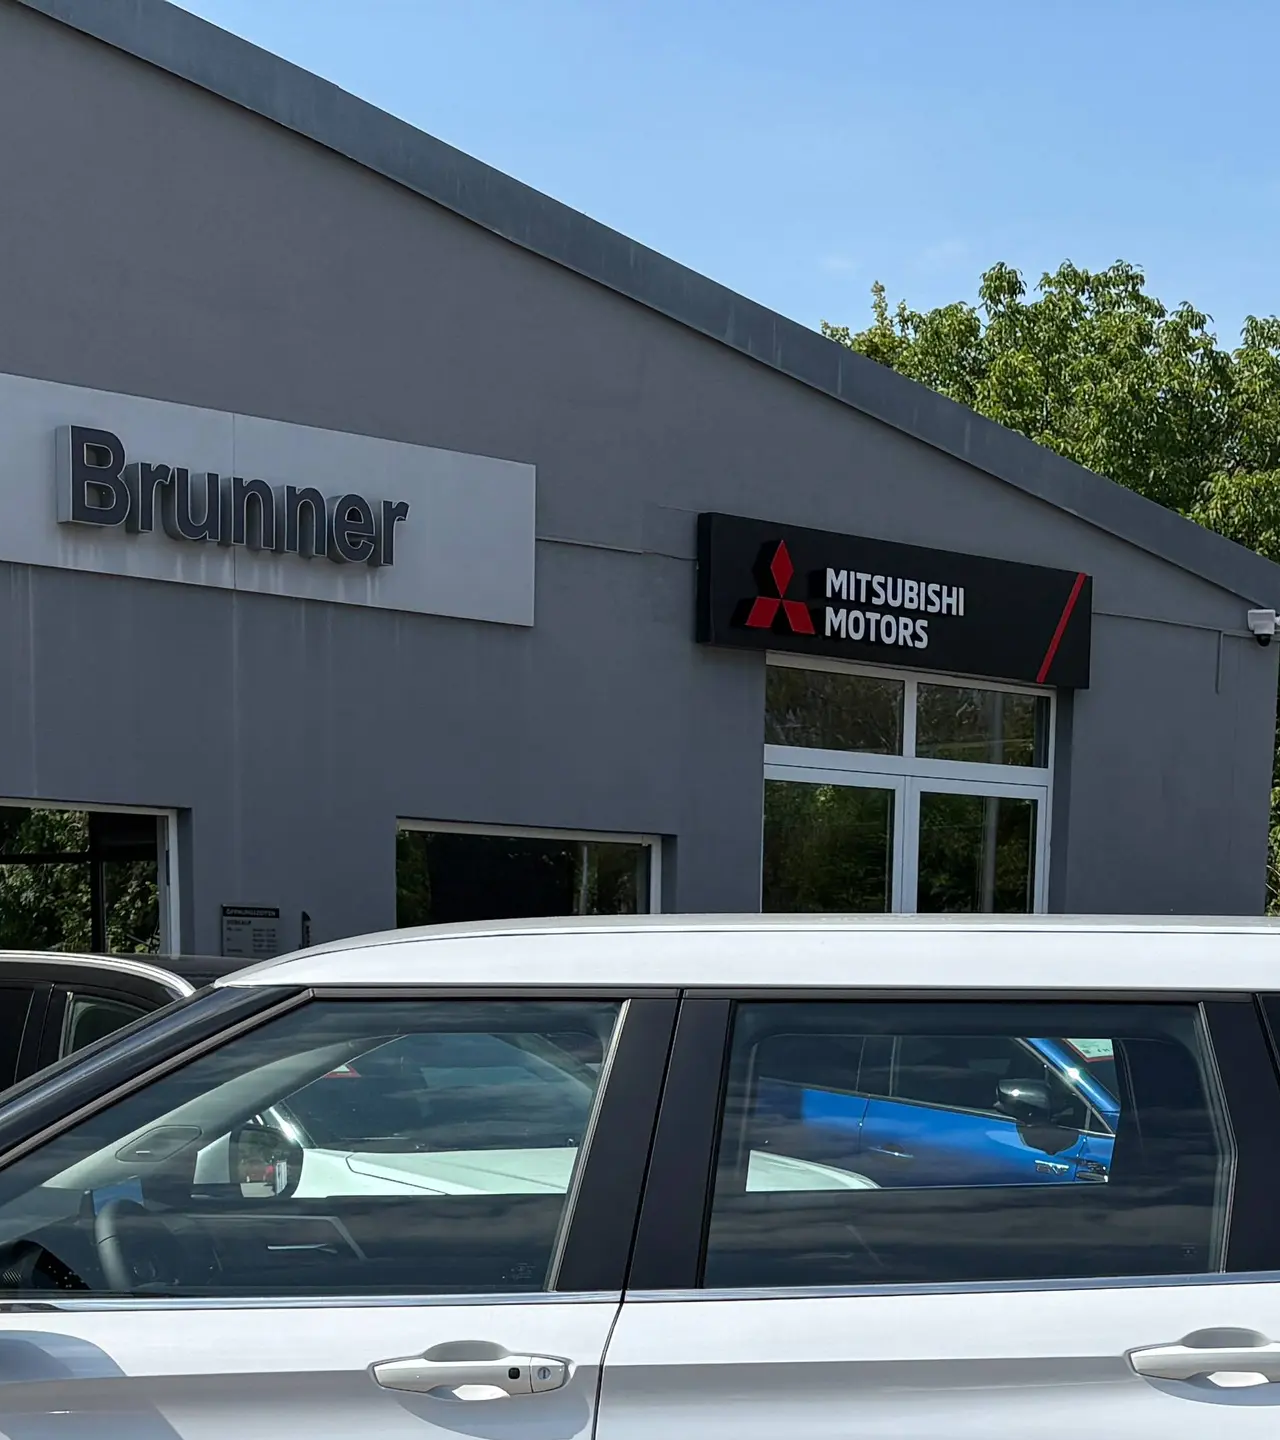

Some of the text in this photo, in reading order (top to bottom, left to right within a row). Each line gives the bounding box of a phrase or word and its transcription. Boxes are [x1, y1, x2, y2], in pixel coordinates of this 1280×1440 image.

[57, 424, 410, 568] Brunner
[825, 567, 965, 617] MITSUBISHI
[825, 607, 929, 649] MOTORS
